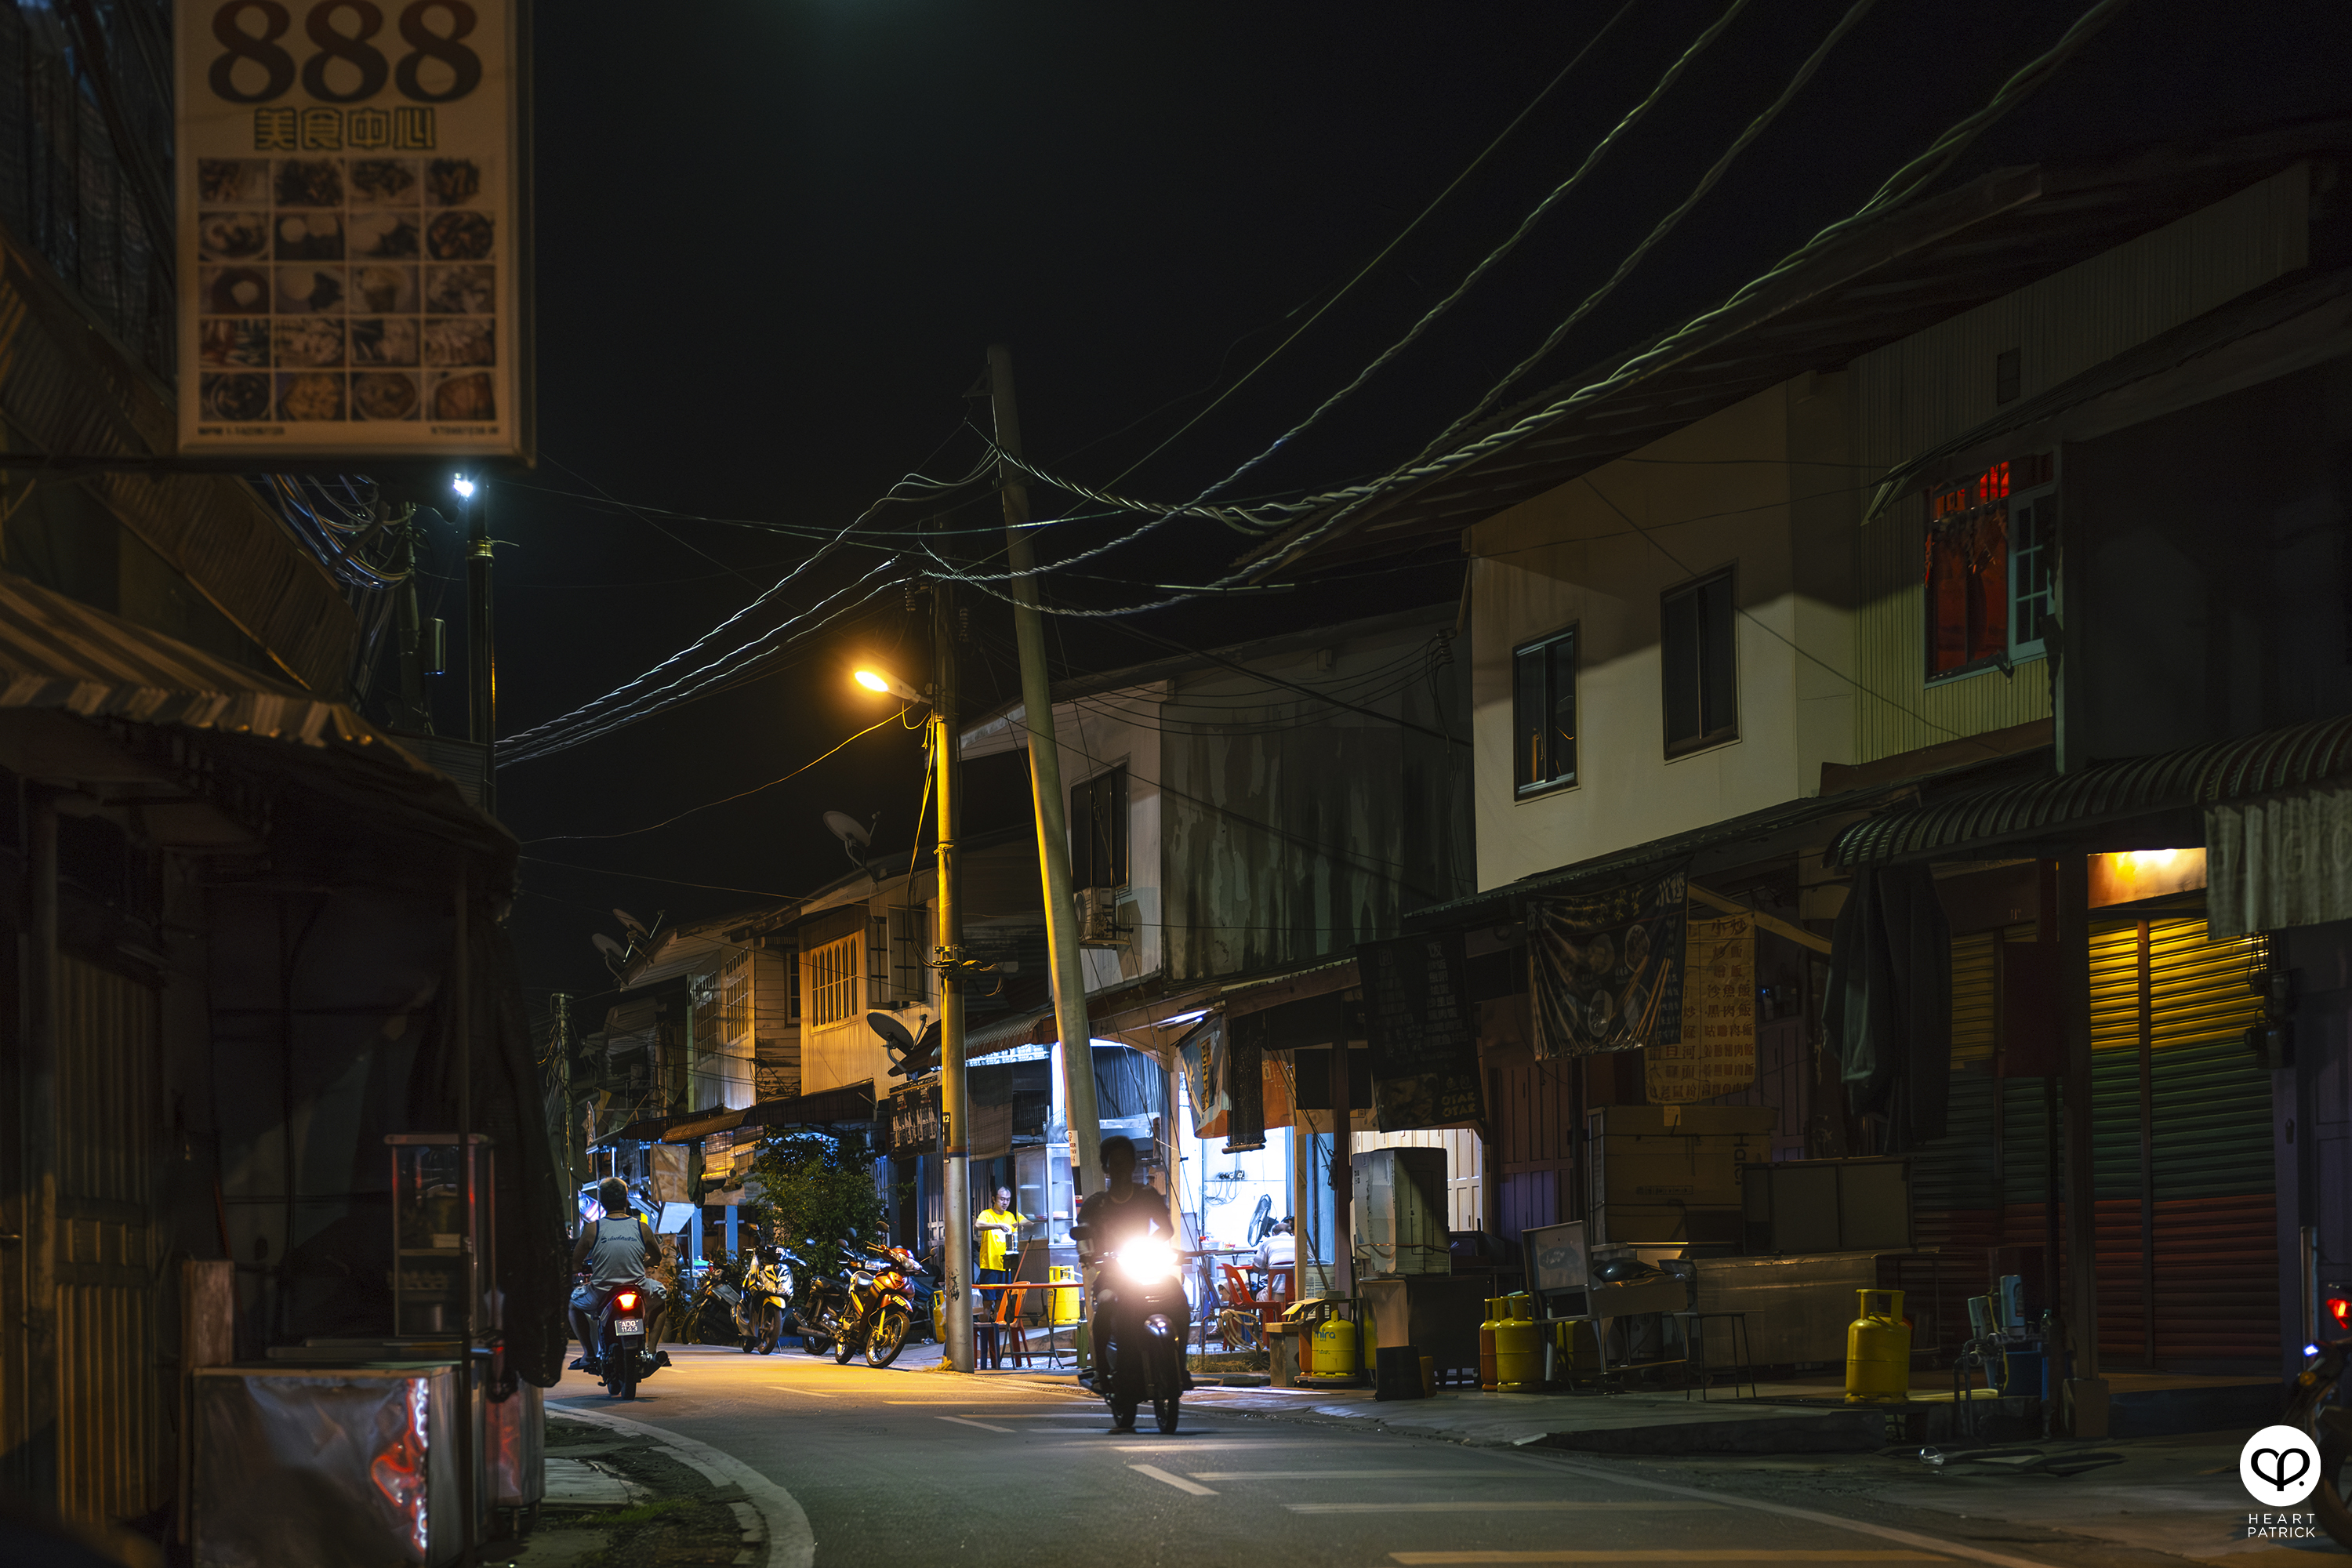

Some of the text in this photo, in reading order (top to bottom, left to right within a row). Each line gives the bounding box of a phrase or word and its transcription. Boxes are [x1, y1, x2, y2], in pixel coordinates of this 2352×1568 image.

[209, 0, 483, 103] 888
[253, 107, 436, 151] 美食中心
[1441, 1091, 1475, 1106] OTAK
[1442, 1103, 1476, 1117] OTAK
[1314, 1327, 1336, 1339] mira
